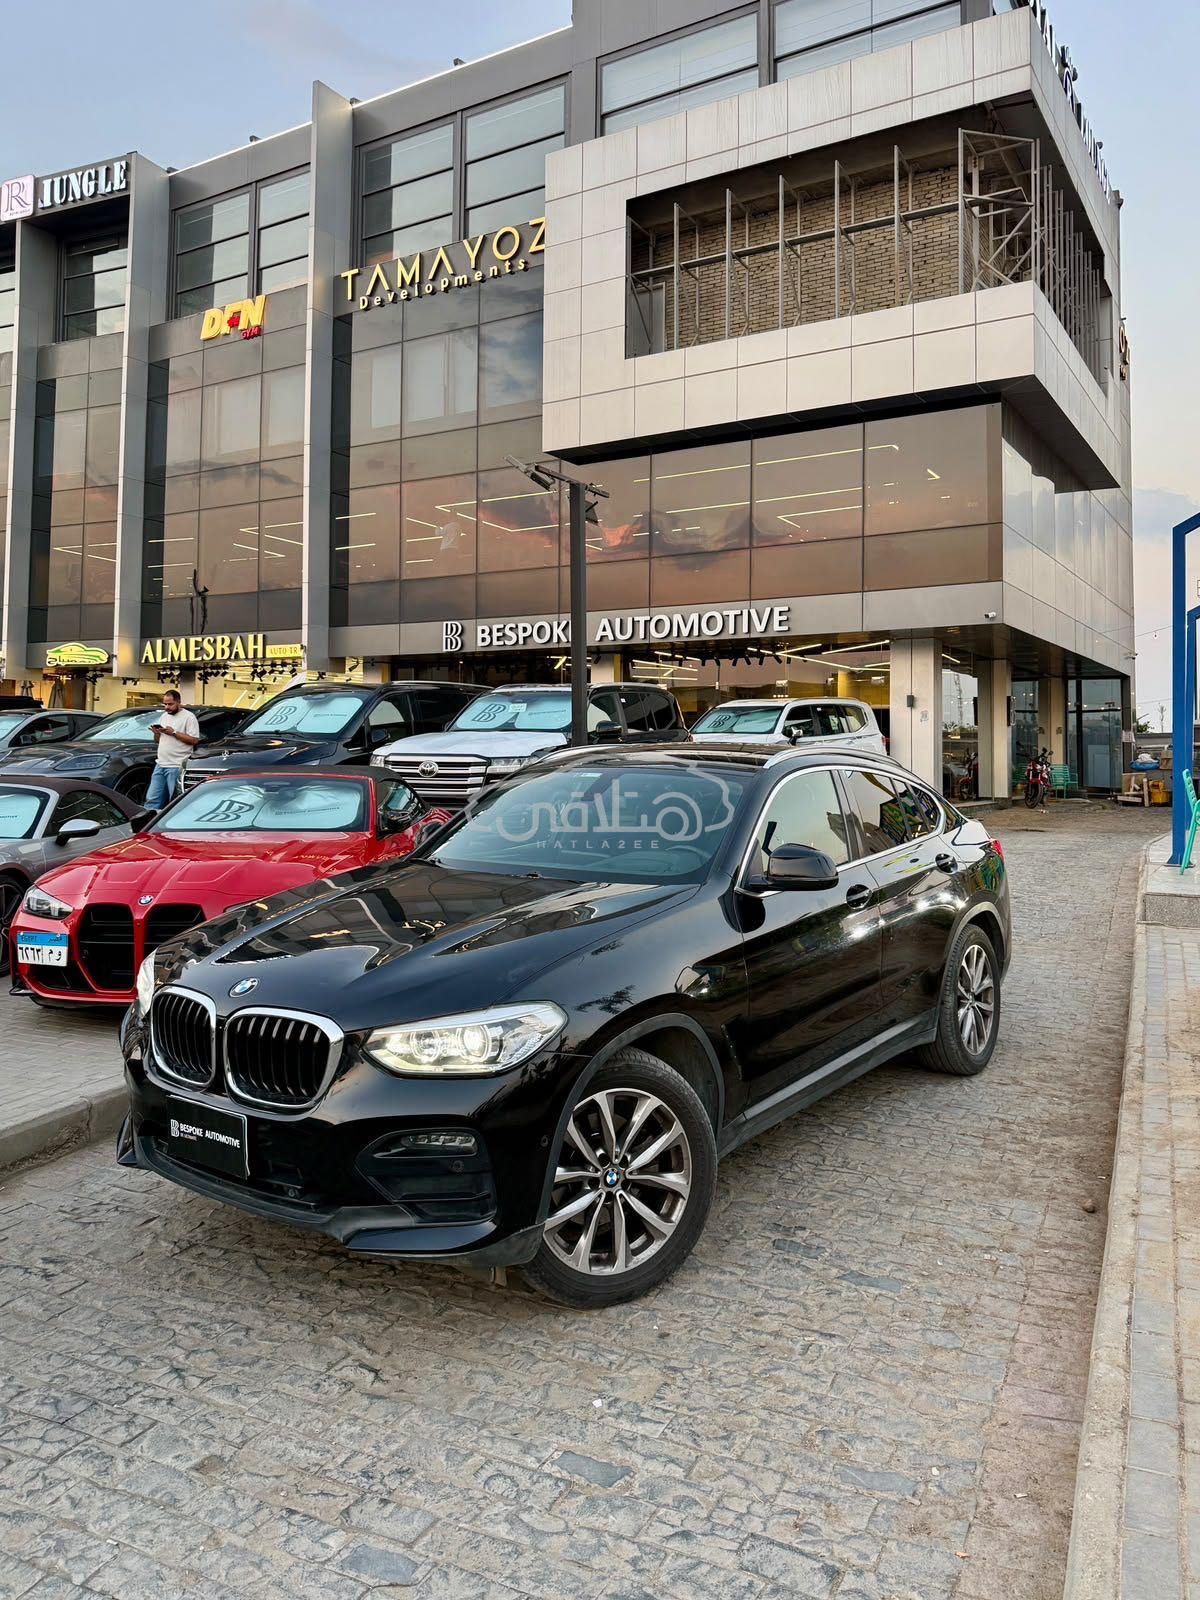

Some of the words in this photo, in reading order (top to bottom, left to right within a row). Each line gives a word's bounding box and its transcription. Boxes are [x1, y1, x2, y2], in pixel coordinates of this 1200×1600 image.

[38, 159, 128, 210] JUNGLE
[341, 216, 545, 301] TAMAYOZ
[359, 257, 526, 310] Developments
[141, 633, 264, 663] ALMESBAH
[477, 619, 572, 648] BESPOK
[595, 606, 790, 642] AUTOMOTIVE
[180, 1123, 203, 1137] BESPOKE
[205, 1130, 240, 1149] AUTOMOTIVE
